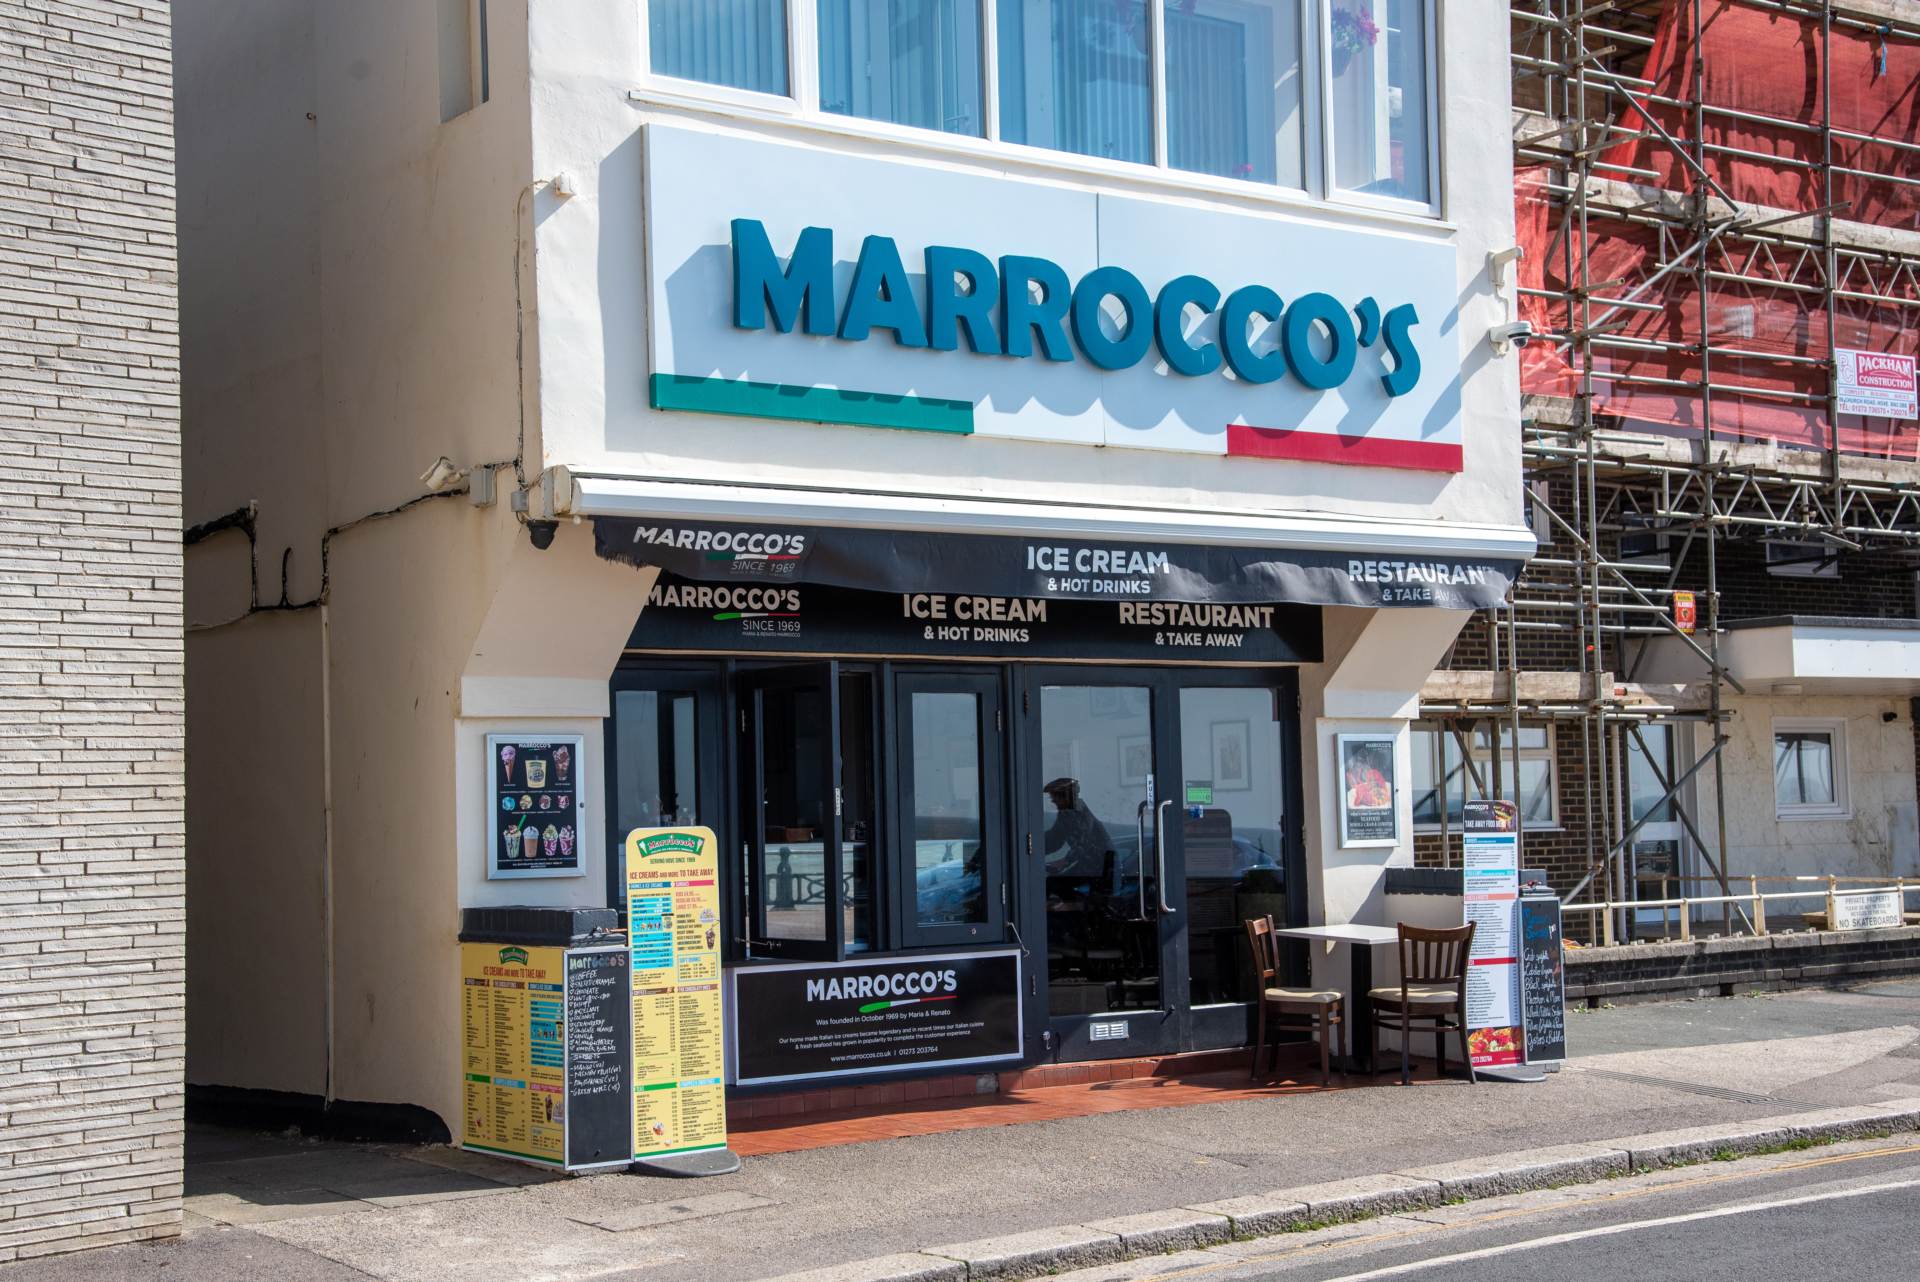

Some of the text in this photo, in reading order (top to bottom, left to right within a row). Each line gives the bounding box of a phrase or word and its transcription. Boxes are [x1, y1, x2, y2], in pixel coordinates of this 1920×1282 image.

[731, 218, 1421, 397] MARROCCO'S
[1858, 356, 1912, 378] PACKHAM
[1859, 376, 1913, 389] CONSTRUCTION
[633, 526, 805, 554] MARROCCO'S
[730, 560, 796, 574] SINCE 1969
[1027, 546, 1170, 574] ICE CREAM
[1047, 578, 1151, 594] & HOT DRINKS
[1382, 588, 1392, 602] &
[1395, 588, 1431, 602] TAKE
[903, 593, 1047, 623] ICE CREAM
[1119, 601, 1275, 630] RESTAURANT
[742, 620, 801, 632] SINCE 1969
[923, 625, 1030, 643] & HOT DRINKS
[1155, 632, 1244, 648] & TAKE AWAY
[639, 871, 659, 879] CREAMS
[700, 868, 714, 876] AWAY
[1840, 915, 1898, 928] NO SKATEBOARDS
[806, 970, 957, 1002] MARROCCO'S
[816, 1018, 829, 1026] Was
[830, 1016, 854, 1025] founded
[861, 1014, 884, 1022] October
[908, 1010, 924, 1018] Maria
[931, 1008, 951, 1017] Renato
[899, 1047, 915, 1056] 01273
